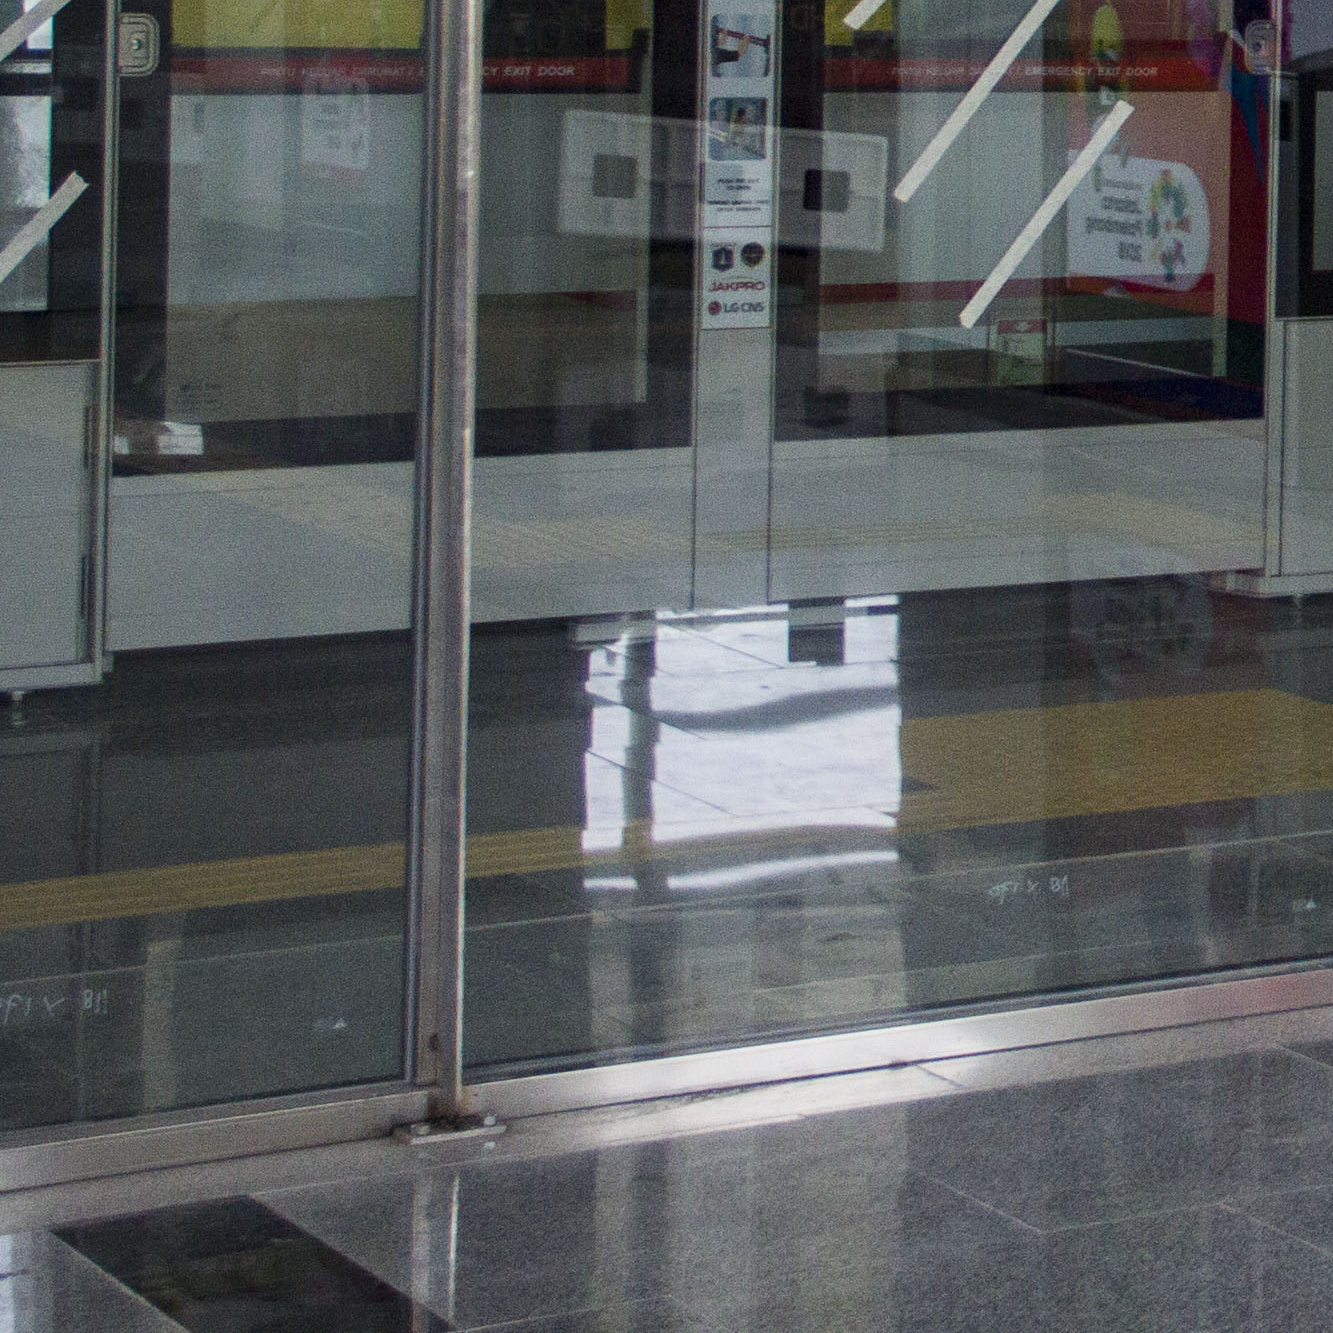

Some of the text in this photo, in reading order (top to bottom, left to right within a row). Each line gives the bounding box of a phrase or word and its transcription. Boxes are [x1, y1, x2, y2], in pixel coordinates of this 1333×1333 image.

[503, 66, 532, 76] EXIT
[537, 66, 576, 76] DOOR
[1025, 67, 1093, 76] EMERGENCY
[1097, 66, 1122, 76] EXIT
[1125, 66, 1158, 76] DOOR
[708, 280, 765, 292] JAKPRO
[724, 302, 765, 313] LG CNS
